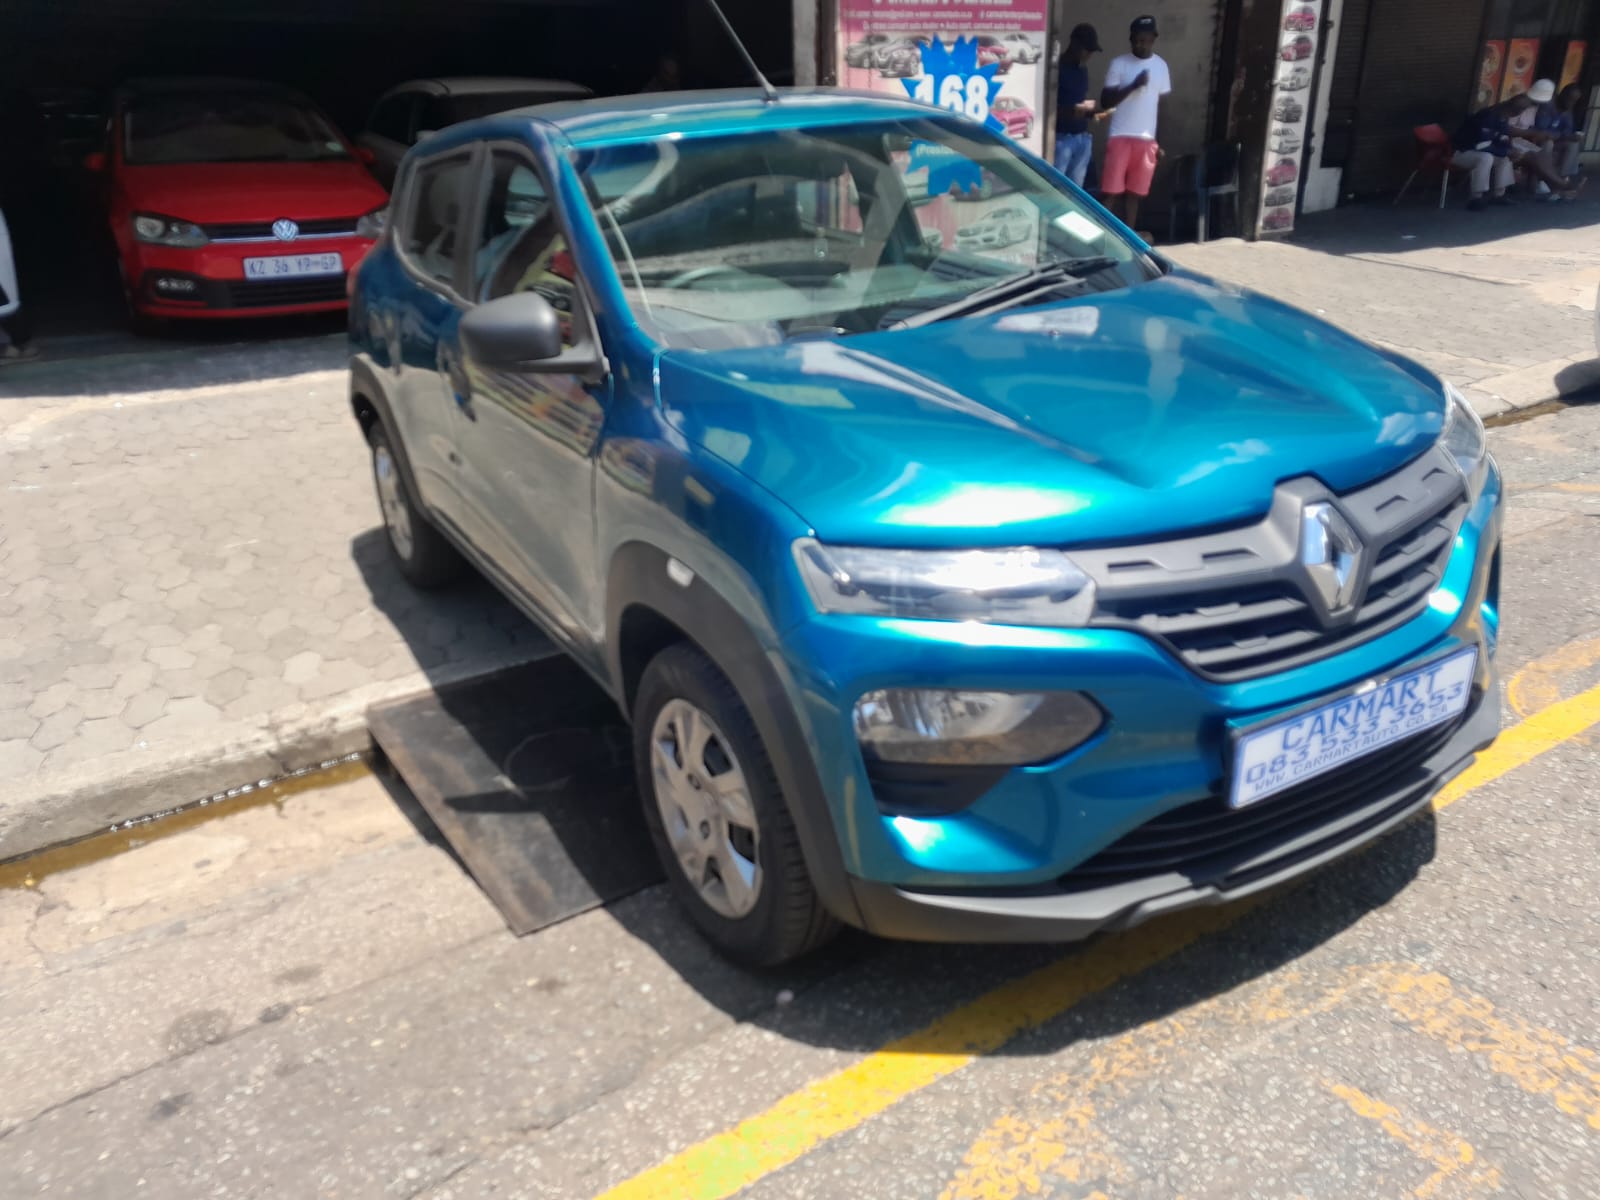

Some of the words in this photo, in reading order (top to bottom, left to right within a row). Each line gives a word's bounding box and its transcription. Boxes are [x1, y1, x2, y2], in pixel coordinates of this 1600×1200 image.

[914, 74, 989, 123] 168
[1246, 745, 1310, 784] 083
[1321, 715, 1381, 753] 533
[1390, 681, 1464, 725] 3653
[1282, 669, 1443, 751] CARMART
